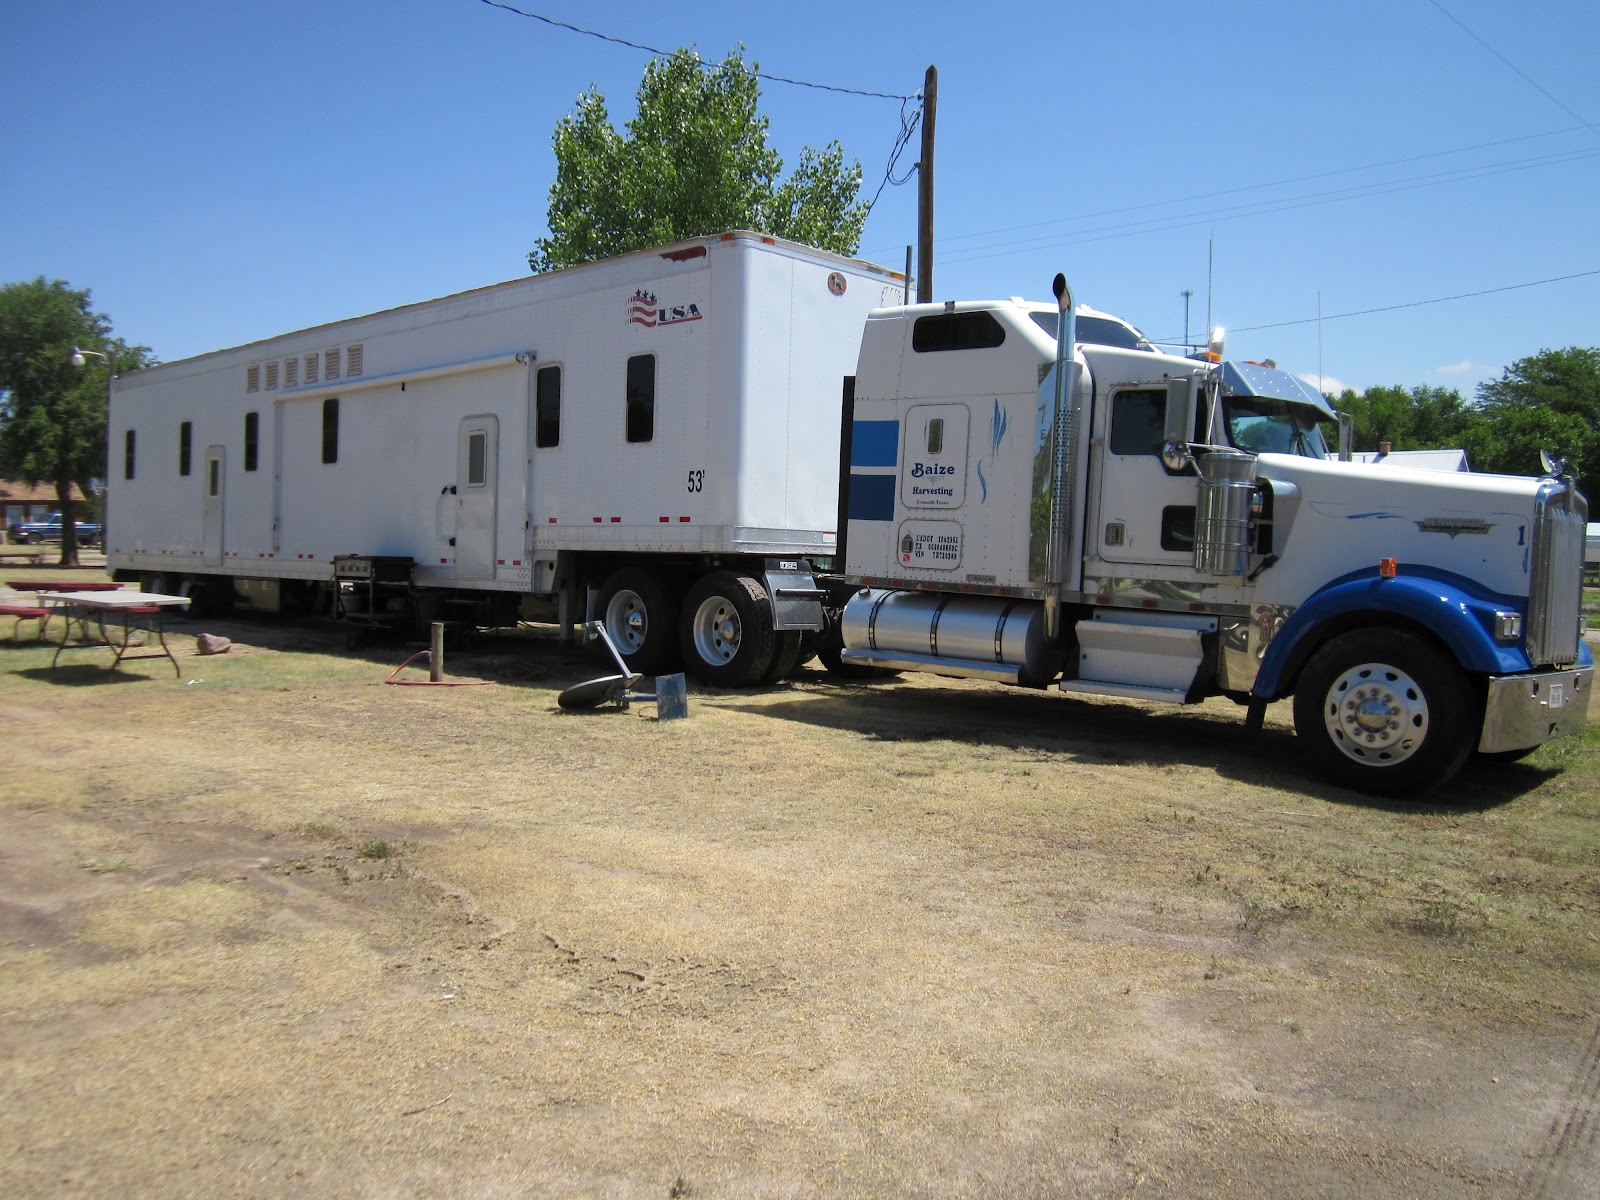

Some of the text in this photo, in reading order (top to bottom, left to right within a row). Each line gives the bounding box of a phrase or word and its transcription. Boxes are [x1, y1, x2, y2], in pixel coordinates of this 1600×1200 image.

[658, 303, 701, 321] USA
[911, 462, 955, 478] Baize
[912, 486, 953, 496] Harvesting
[1424, 517, 1485, 528] KENWORTH
[916, 534, 933, 543] USDOT
[1518, 525, 1525, 546] 1
[915, 542, 923, 550] TX
[914, 550, 925, 558] VIN
